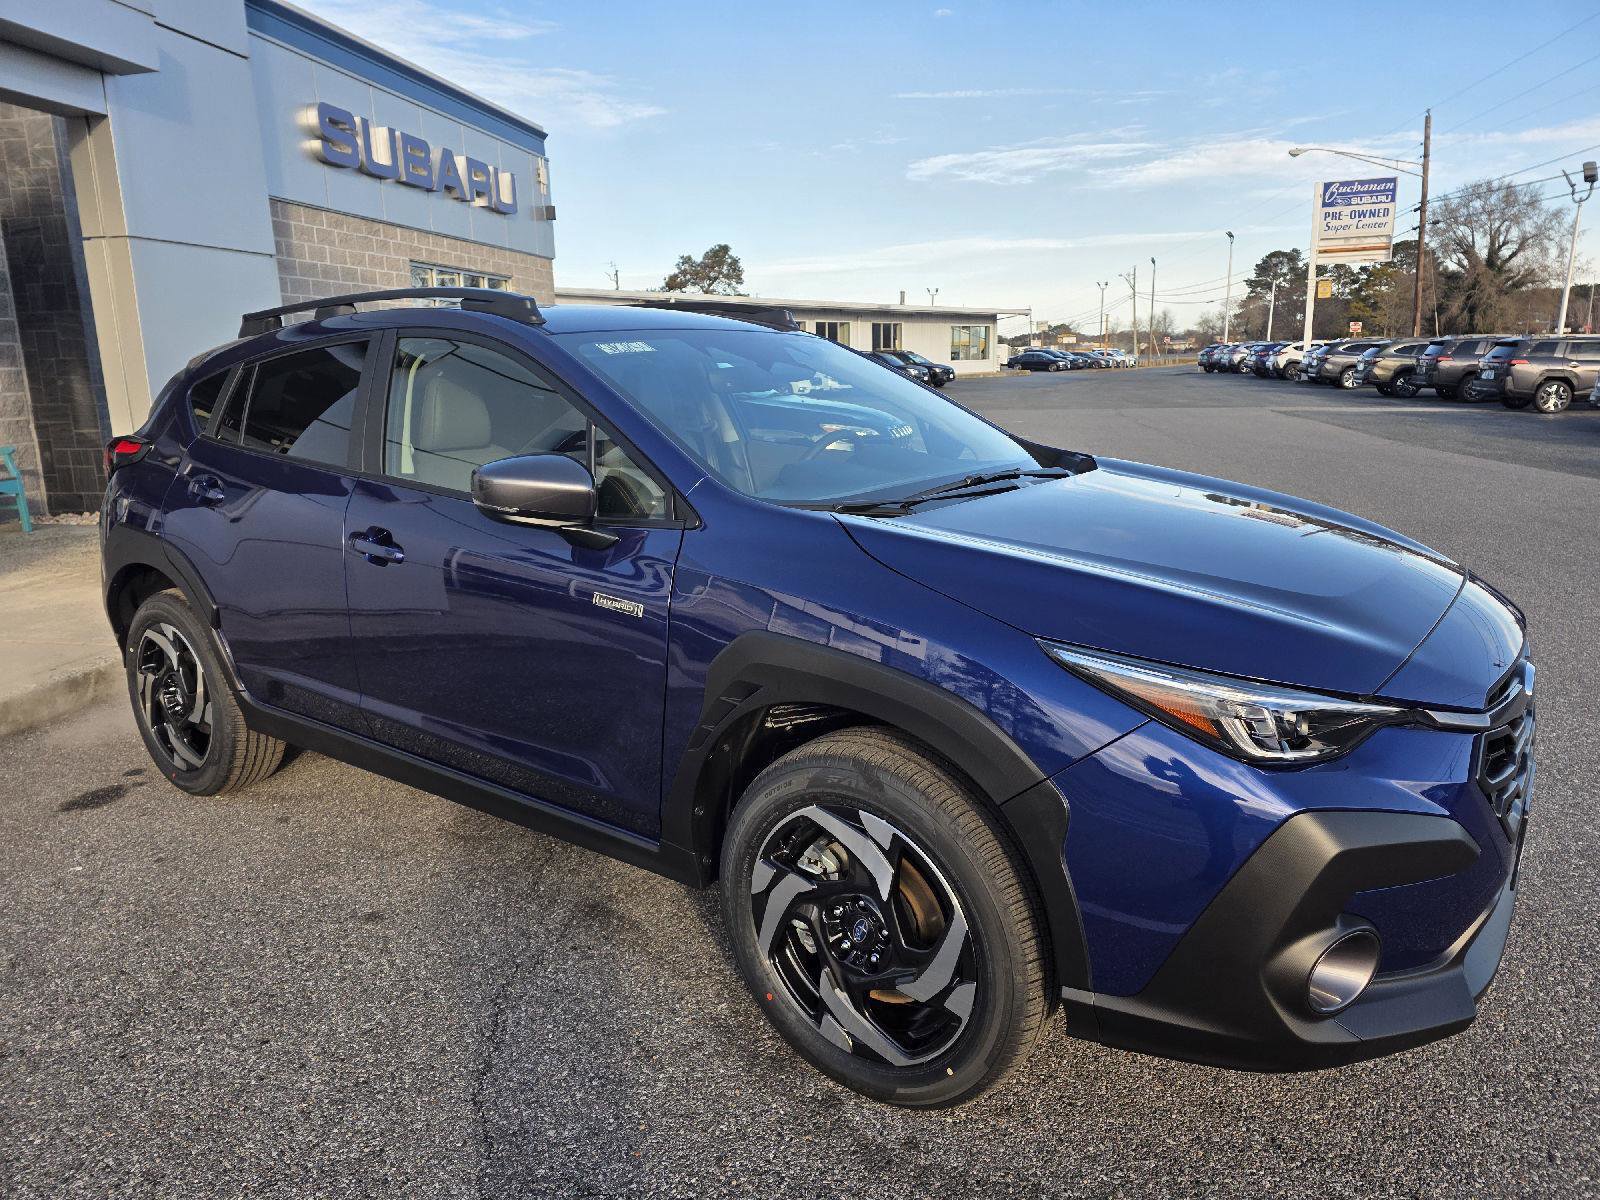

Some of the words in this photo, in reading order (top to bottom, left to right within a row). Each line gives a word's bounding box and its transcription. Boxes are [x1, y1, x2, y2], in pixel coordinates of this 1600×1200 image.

[316, 101, 518, 215] SUBARU
[1325, 182, 1394, 203] Buchanan
[1351, 195, 1391, 204] SUBARU
[1324, 207, 1389, 221] PRE-OWNED
[1323, 221, 1352, 234] Super
[1355, 219, 1388, 230] Center
[600, 597, 634, 611] HYBRID
